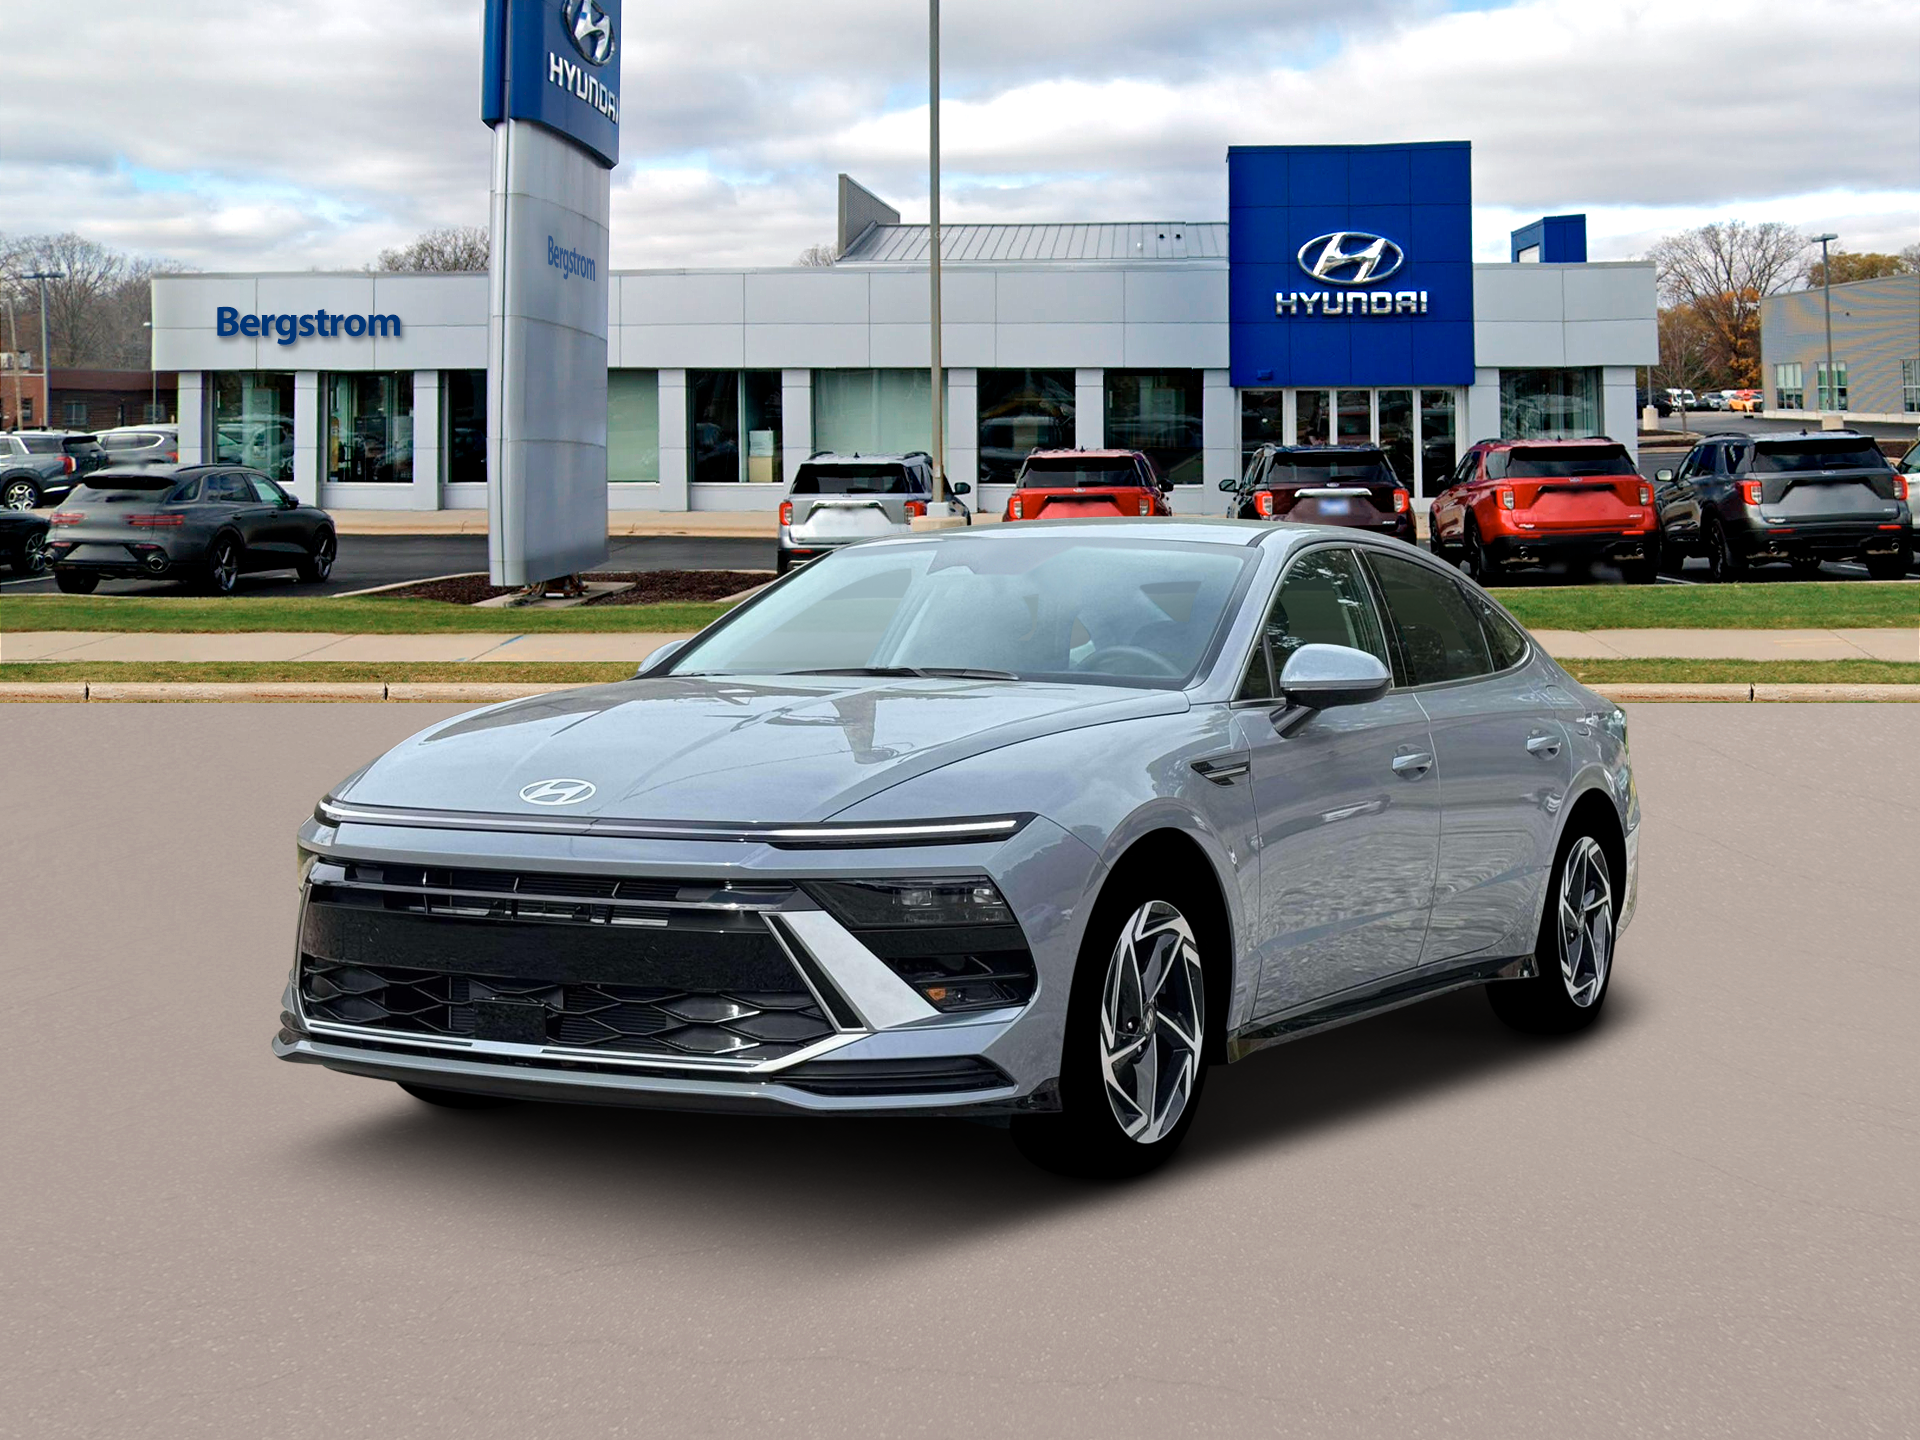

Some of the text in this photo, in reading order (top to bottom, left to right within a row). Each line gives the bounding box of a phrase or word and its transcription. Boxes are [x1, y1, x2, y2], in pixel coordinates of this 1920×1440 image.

[549, 52, 618, 124] HYUNDAI
[547, 235, 596, 282] Bergstrom
[1275, 290, 1428, 315] HYUNDAI
[217, 306, 401, 346] Bergstrom
